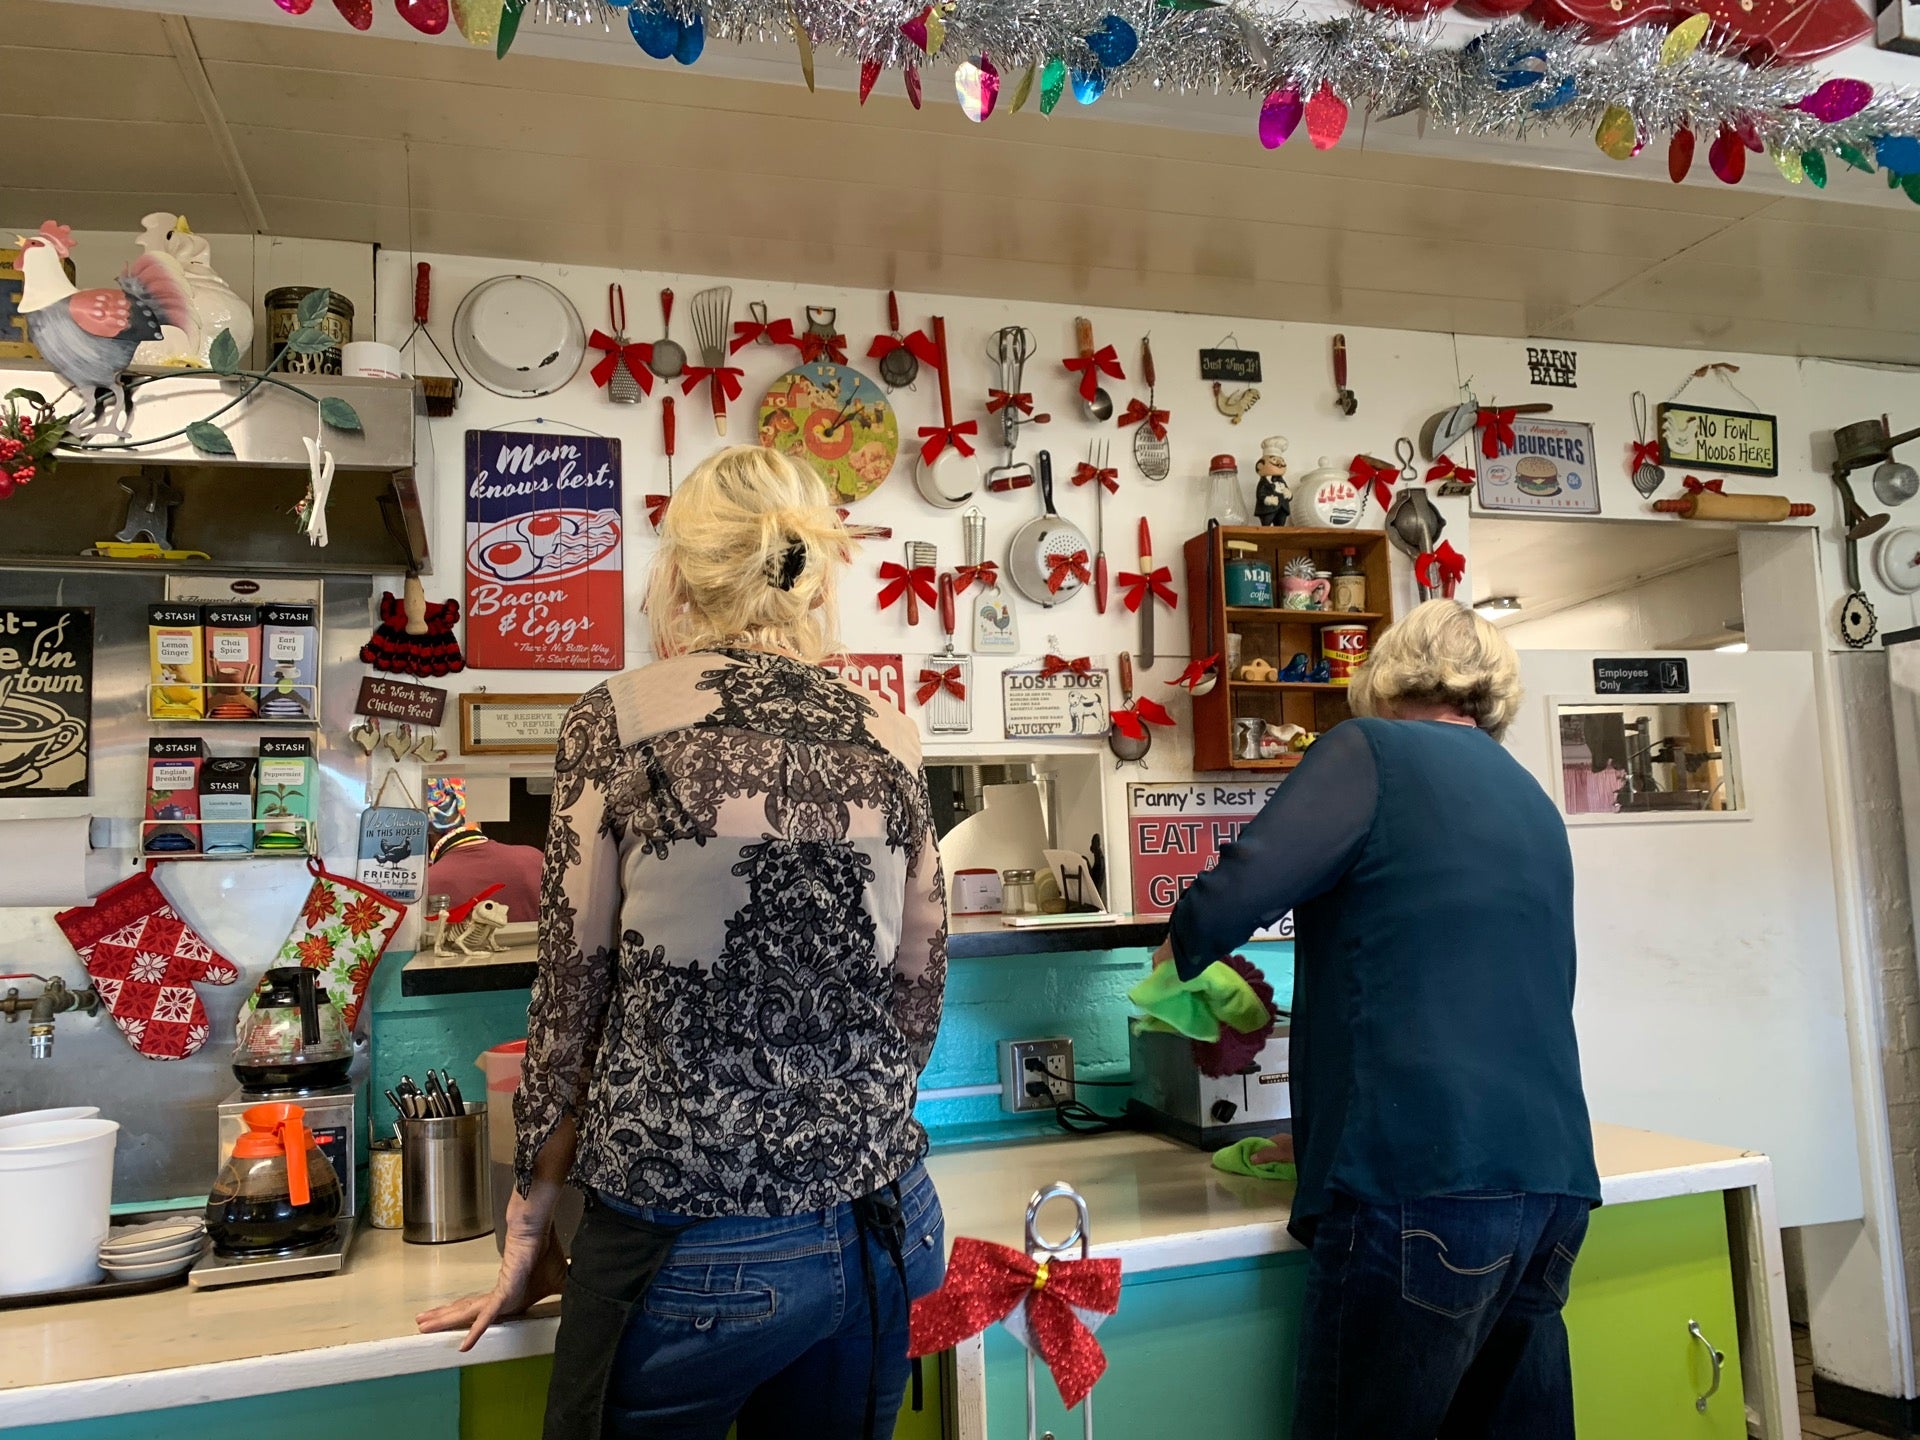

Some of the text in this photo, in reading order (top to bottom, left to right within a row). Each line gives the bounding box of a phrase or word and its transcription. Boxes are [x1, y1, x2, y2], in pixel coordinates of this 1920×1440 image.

[1526, 347, 1577, 370] BARN
[1529, 366, 1578, 388] BABE
[1698, 415, 1717, 438] NO
[1696, 439, 1771, 464] MOODS HERE
[496, 443, 582, 475] Mom
[469, 461, 615, 499] knows best,
[469, 583, 569, 617] Bacon
[164, 612, 196, 621] STASH
[221, 614, 252, 623] STASH
[279, 612, 309, 621] STASH
[498, 604, 595, 645] & Eggs
[161, 641, 189, 649] Lemon
[277, 644, 296, 652] Grey
[1339, 634, 1364, 650] KC
[38, 641, 77, 668] in
[220, 648, 242, 656] Spice
[590, 643, 610, 656] Way
[14, 667, 84, 693] town
[1599, 668, 1649, 679] Employees
[1009, 674, 1103, 690] LOST DOG
[1599, 681, 1621, 691] Only
[370, 683, 438, 704] We Work For
[366, 698, 434, 719] Chicken Feed
[496, 713, 508, 721] WE
[514, 713, 552, 721] RESERVE
[165, 744, 196, 752] STASH
[275, 743, 305, 751] STASH
[160, 769, 187, 777] English
[264, 771, 301, 779] Peppermint
[210, 782, 239, 790] STASH
[1134, 787, 1206, 811] Fanny's
[1214, 787, 1256, 805] Rest
[366, 828, 421, 838] IN THIS HOUSE
[1138, 822, 1203, 855] EAT
[363, 870, 417, 879] FRIENDS
